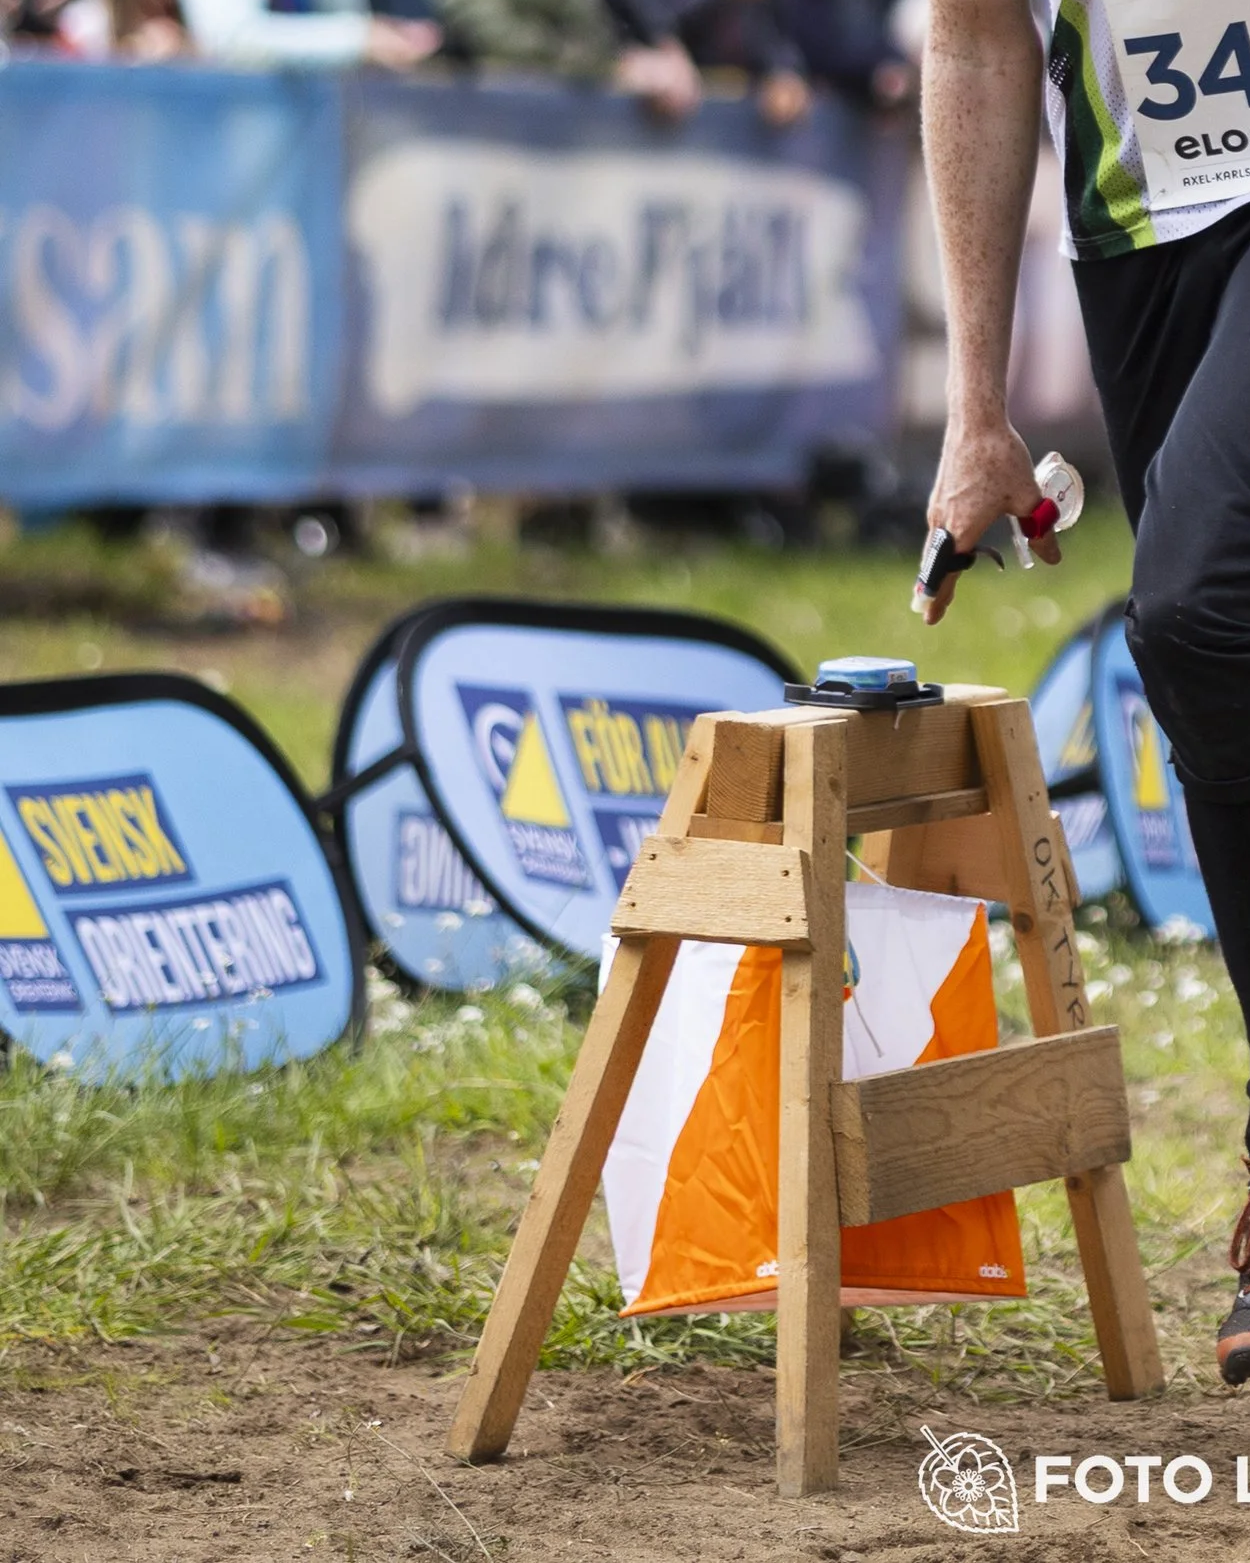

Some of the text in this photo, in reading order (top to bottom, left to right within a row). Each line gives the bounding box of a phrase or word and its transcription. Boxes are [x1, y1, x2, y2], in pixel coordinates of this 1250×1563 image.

[566, 697, 655, 794] FÖR
[17, 786, 187, 886] SVENSK
[75, 888, 317, 1009] ORIENTERING
